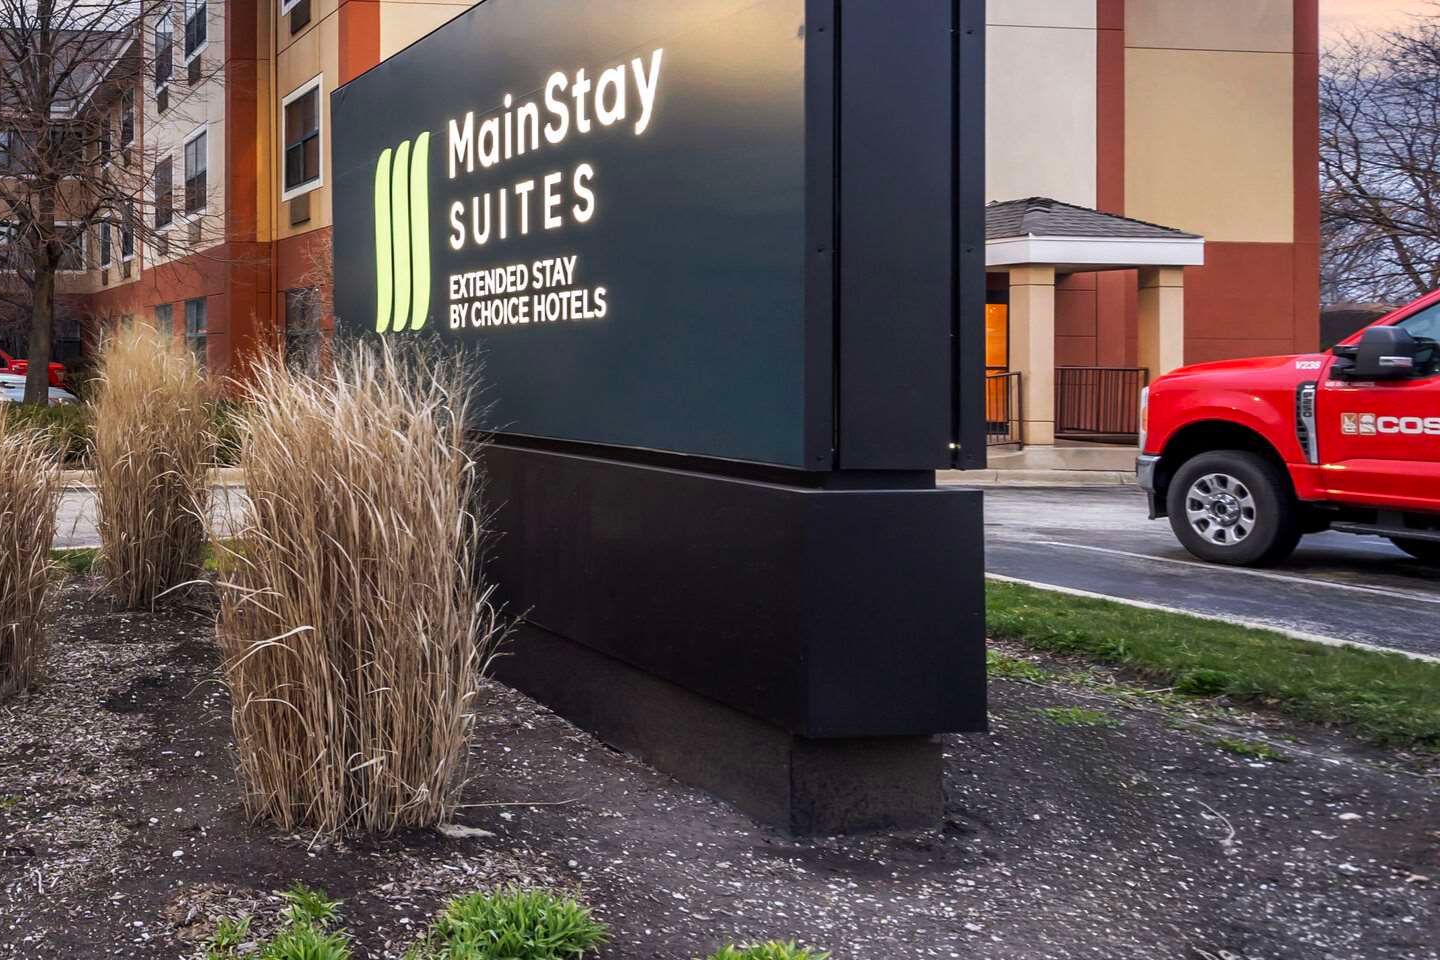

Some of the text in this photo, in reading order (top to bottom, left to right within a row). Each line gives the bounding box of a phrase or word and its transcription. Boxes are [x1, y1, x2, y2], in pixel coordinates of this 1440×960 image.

[448, 48, 663, 179] MainStay
[449, 163, 594, 250] SUITES
[449, 255, 577, 300] EXTENDED STAY
[450, 286, 607, 329] BY CHOICE HOTELS
[1377, 416, 1440, 435] COS
